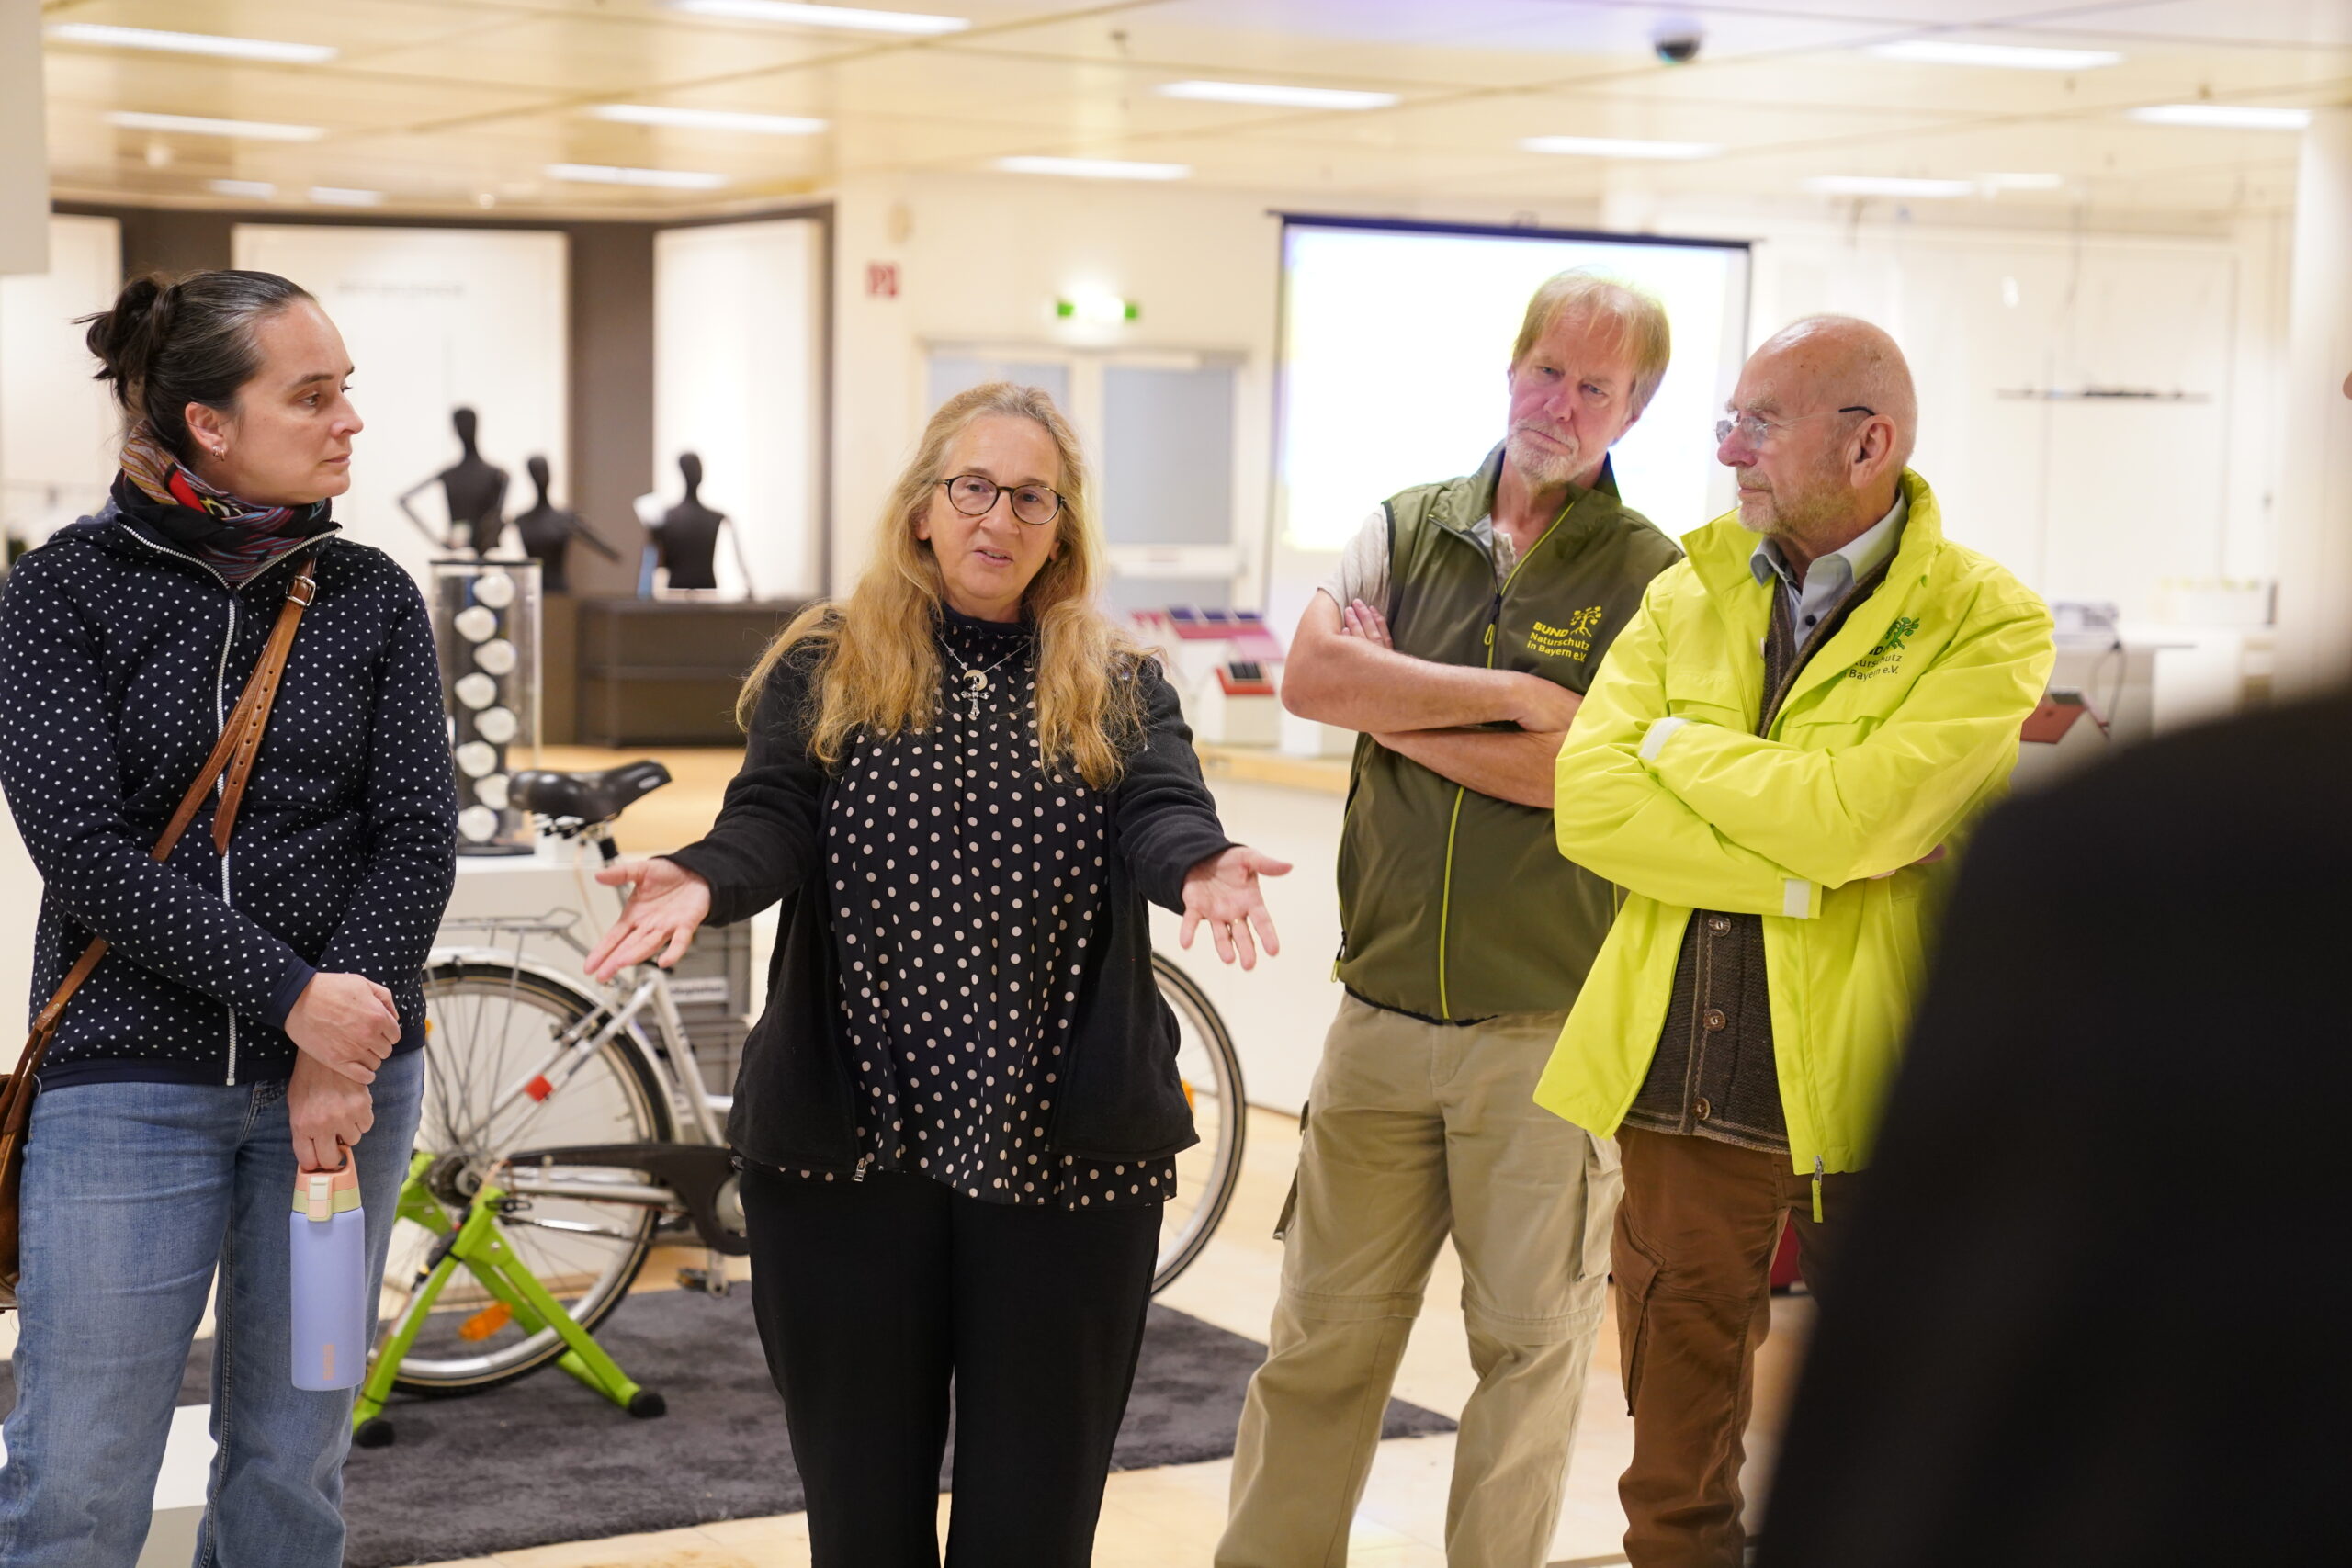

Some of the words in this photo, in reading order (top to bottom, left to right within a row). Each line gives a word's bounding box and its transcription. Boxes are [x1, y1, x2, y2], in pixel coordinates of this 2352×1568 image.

[1532, 621, 1569, 637] BUND
[1527, 640, 1537, 649] in
[1538, 644, 1572, 658] Bayern
[1530, 632, 1590, 651] Naturschutz
[1849, 668, 1882, 682] Bayern
[1883, 664, 1899, 674] e.V.
